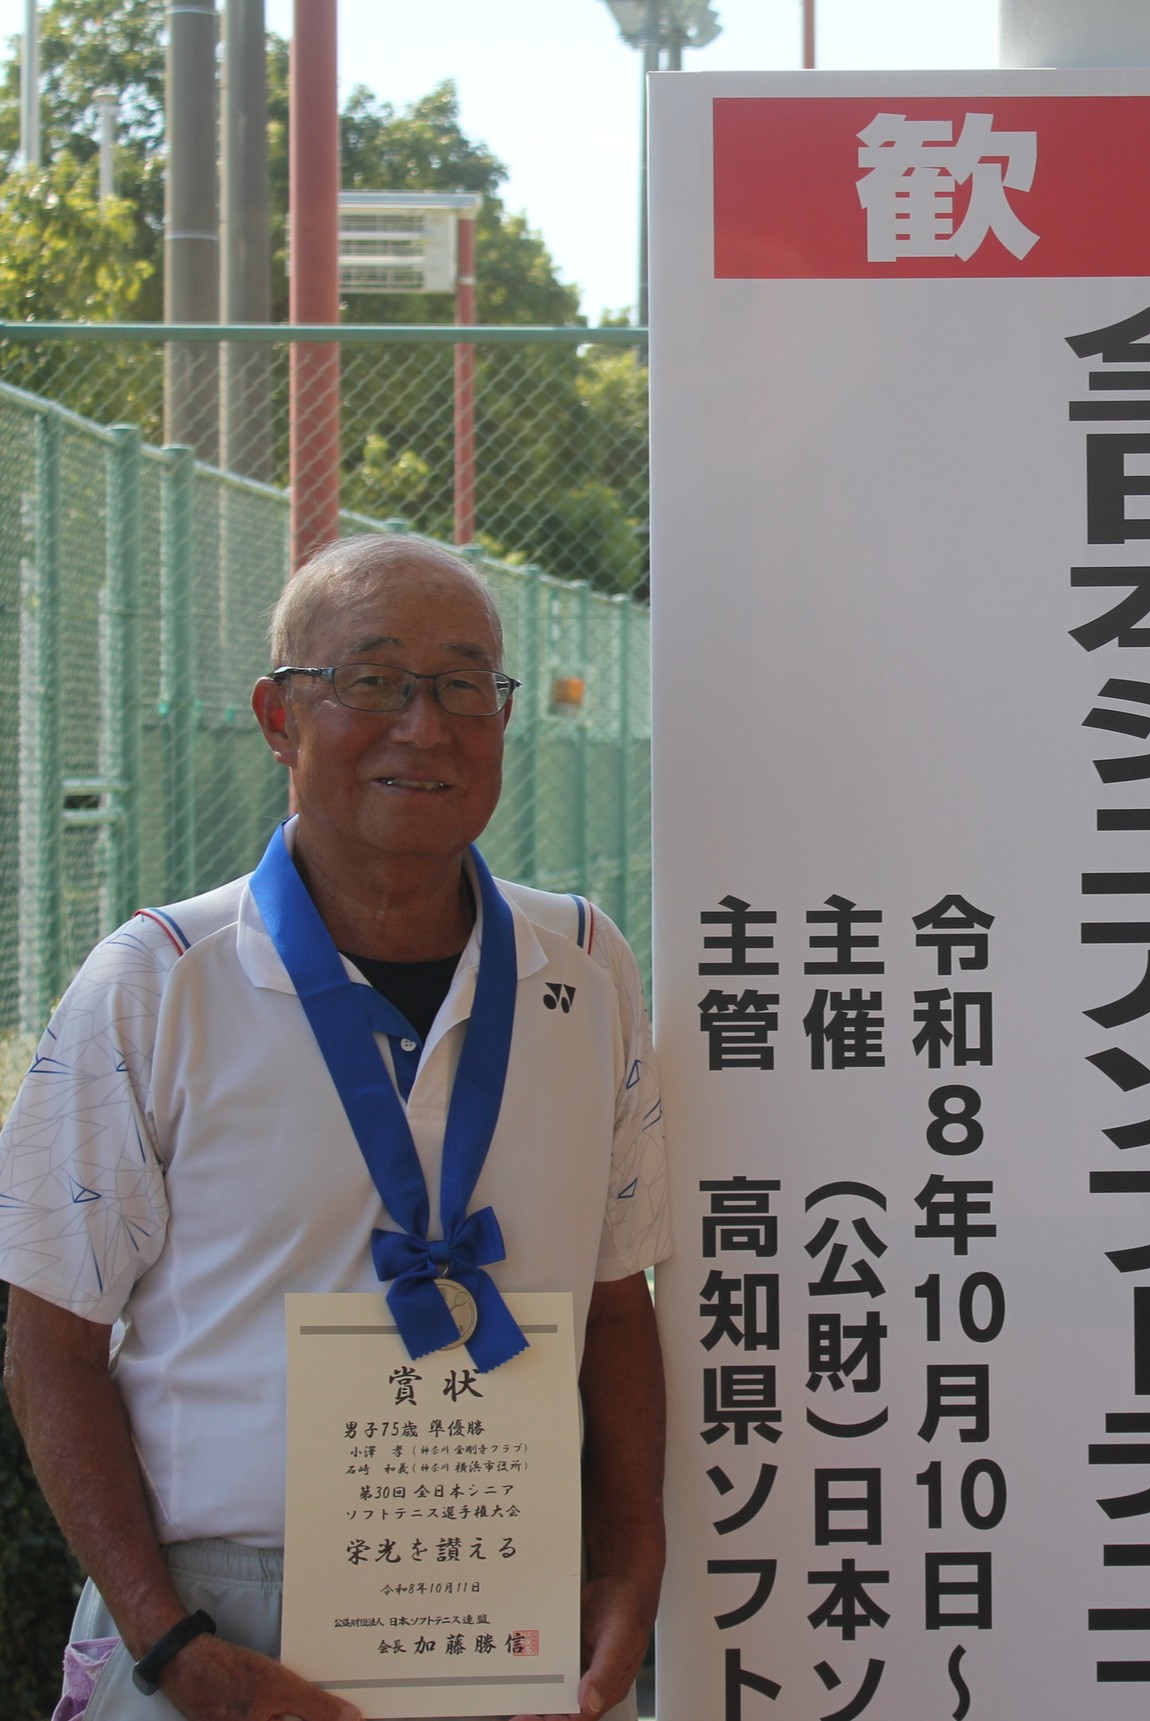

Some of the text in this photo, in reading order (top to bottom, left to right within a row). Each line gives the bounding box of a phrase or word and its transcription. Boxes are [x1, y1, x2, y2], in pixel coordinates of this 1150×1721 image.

[697, 894, 784, 1721] 主管 高知県ソフト
[802, 893, 891, 1721] 主催 (公財)日本ソ
[388, 1365, 484, 1406] 賞状
[344, 1418, 485, 1440] 男子75歳 準優勝
[350, 1445, 377, 1458] 小澤
[392, 1444, 403, 1458] 孝
[359, 1483, 514, 1502] 第30回 全日本シニア
[346, 1504, 521, 1521] ソフトテニス選手権大会
[346, 1536, 517, 1566] 栄光を讃える
[380, 1581, 480, 1596] 令和8年10月11日
[389, 1613, 491, 1627] 日本ソフトテニス連盟
[377, 1639, 407, 1654] 会長
[414, 1632, 526, 1656] 加藤勝信
